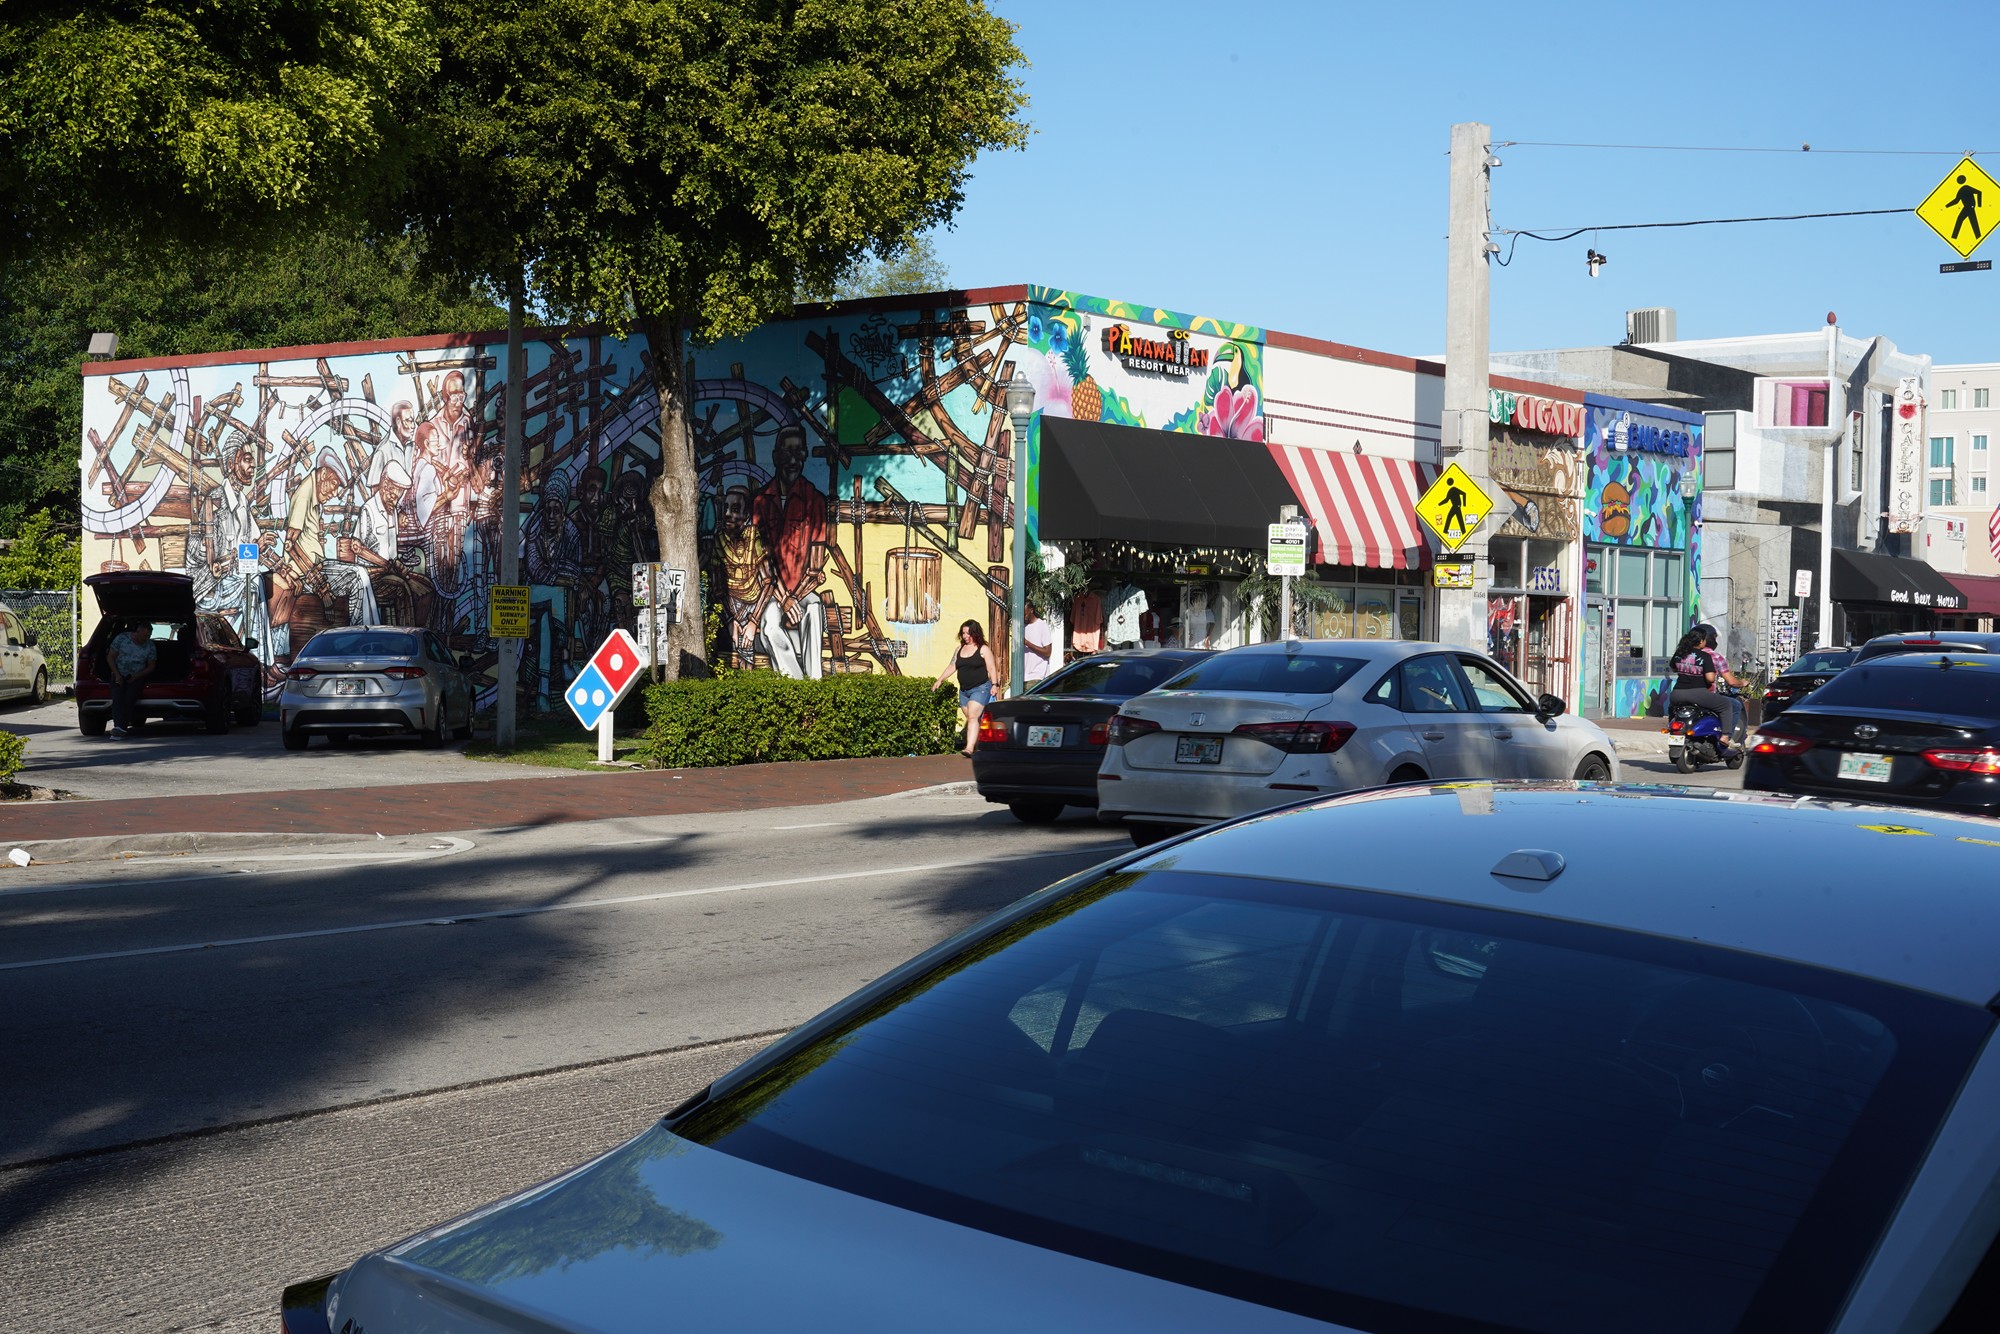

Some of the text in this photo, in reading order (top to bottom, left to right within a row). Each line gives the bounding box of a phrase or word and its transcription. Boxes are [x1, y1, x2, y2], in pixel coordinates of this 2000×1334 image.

[1129, 358, 1190, 376] RESORT WEAR
[1517, 395, 1588, 438] CIGARS
[1628, 423, 1690, 458] BURGER
[1533, 566, 1561, 592] 1551
[495, 589, 527, 597] WARNING
[1891, 589, 1958, 608] Good Beer Here!
